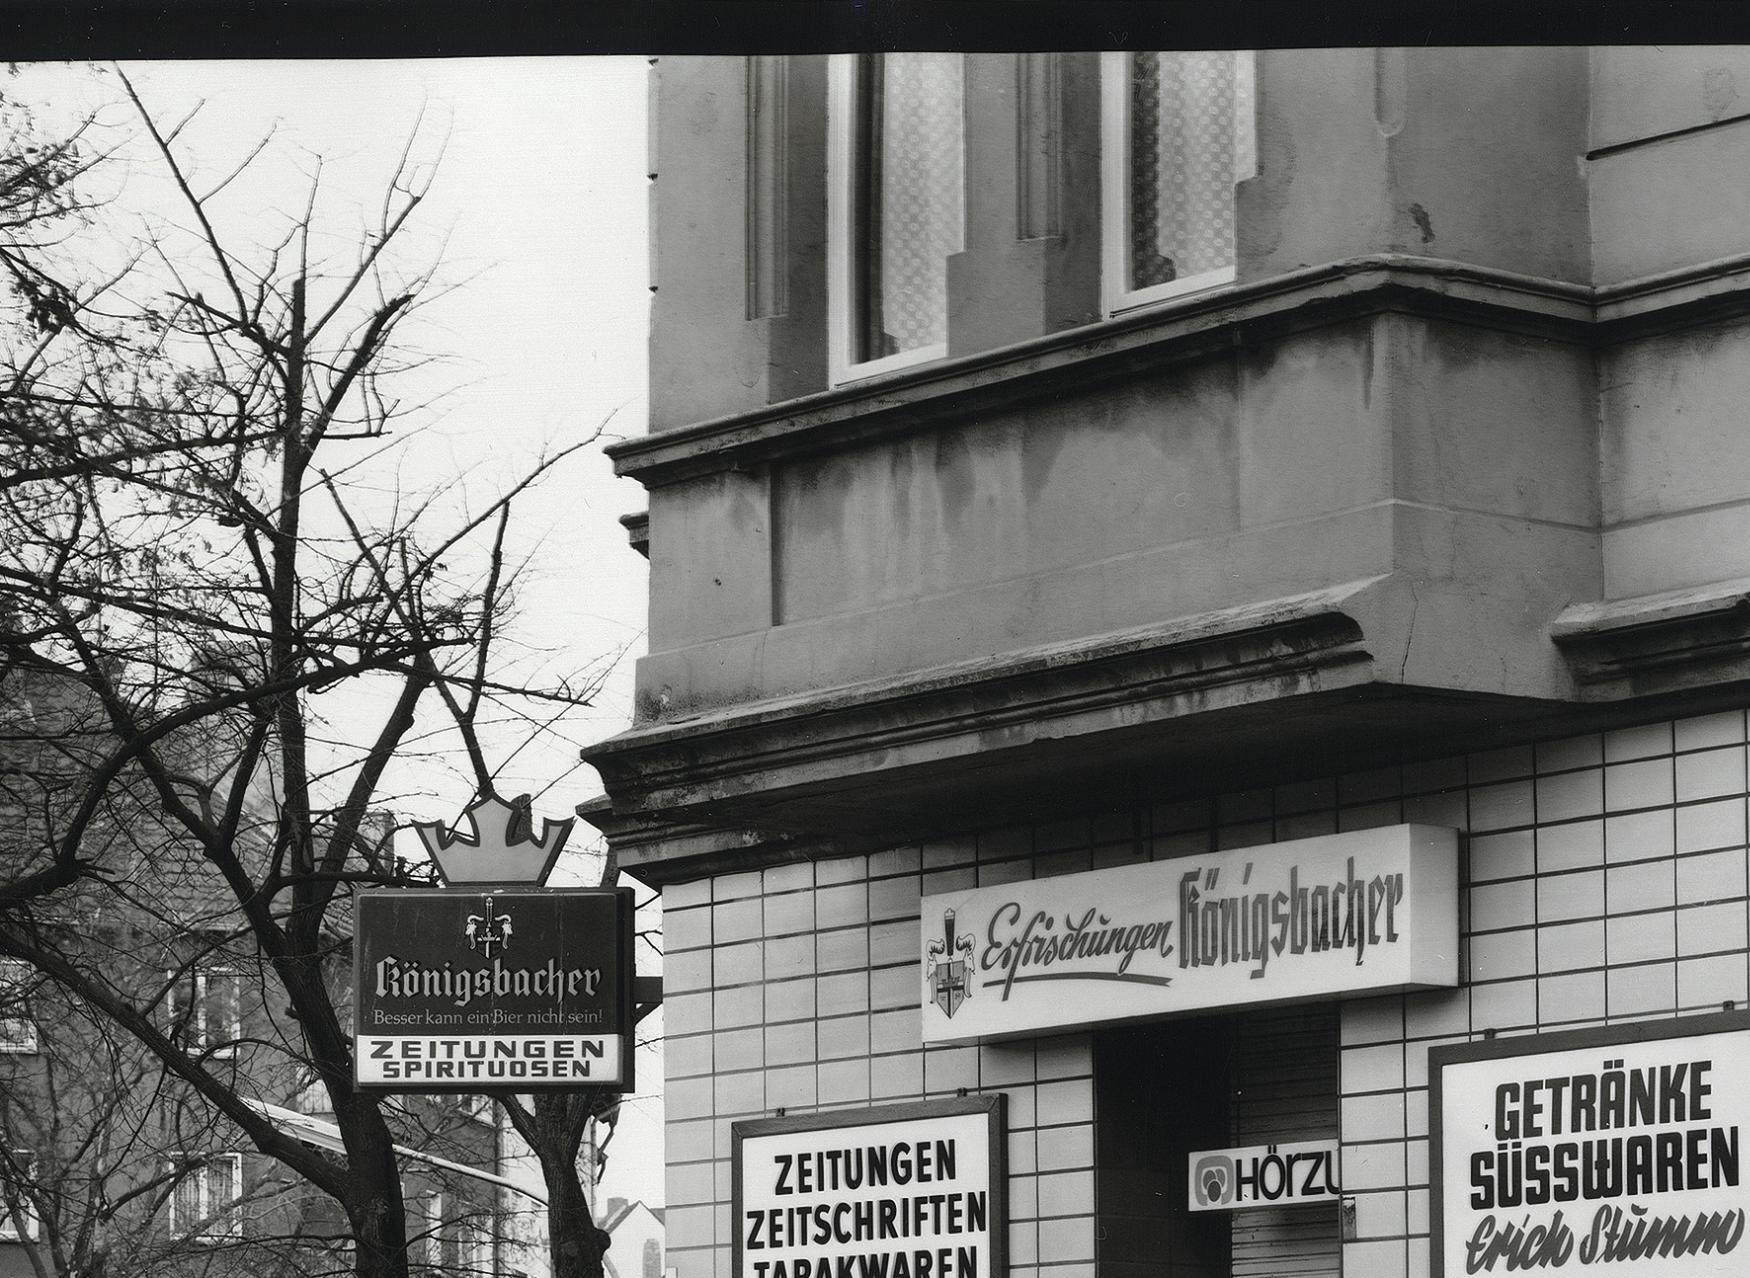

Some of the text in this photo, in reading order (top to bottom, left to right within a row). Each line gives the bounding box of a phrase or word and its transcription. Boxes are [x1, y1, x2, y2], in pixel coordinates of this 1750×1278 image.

[1178, 856, 1404, 979] Königsbacher
[375, 956, 601, 1006] Königsbacher
[374, 1008, 603, 1025] Besser kann ein Bier nicht sein!
[370, 1040, 604, 1059] ZEITUNGEN
[383, 1060, 591, 1078] SPIRITUOSEN
[1494, 1058, 1712, 1141] GETRÄNKE
[774, 1139, 957, 1195] ZEITUNGEN
[1470, 1126, 1740, 1210] SÜSSWAREN
[746, 1191, 987, 1249] ZEITSCHRIFTEN
[1466, 1209, 1574, 1275] Erich
